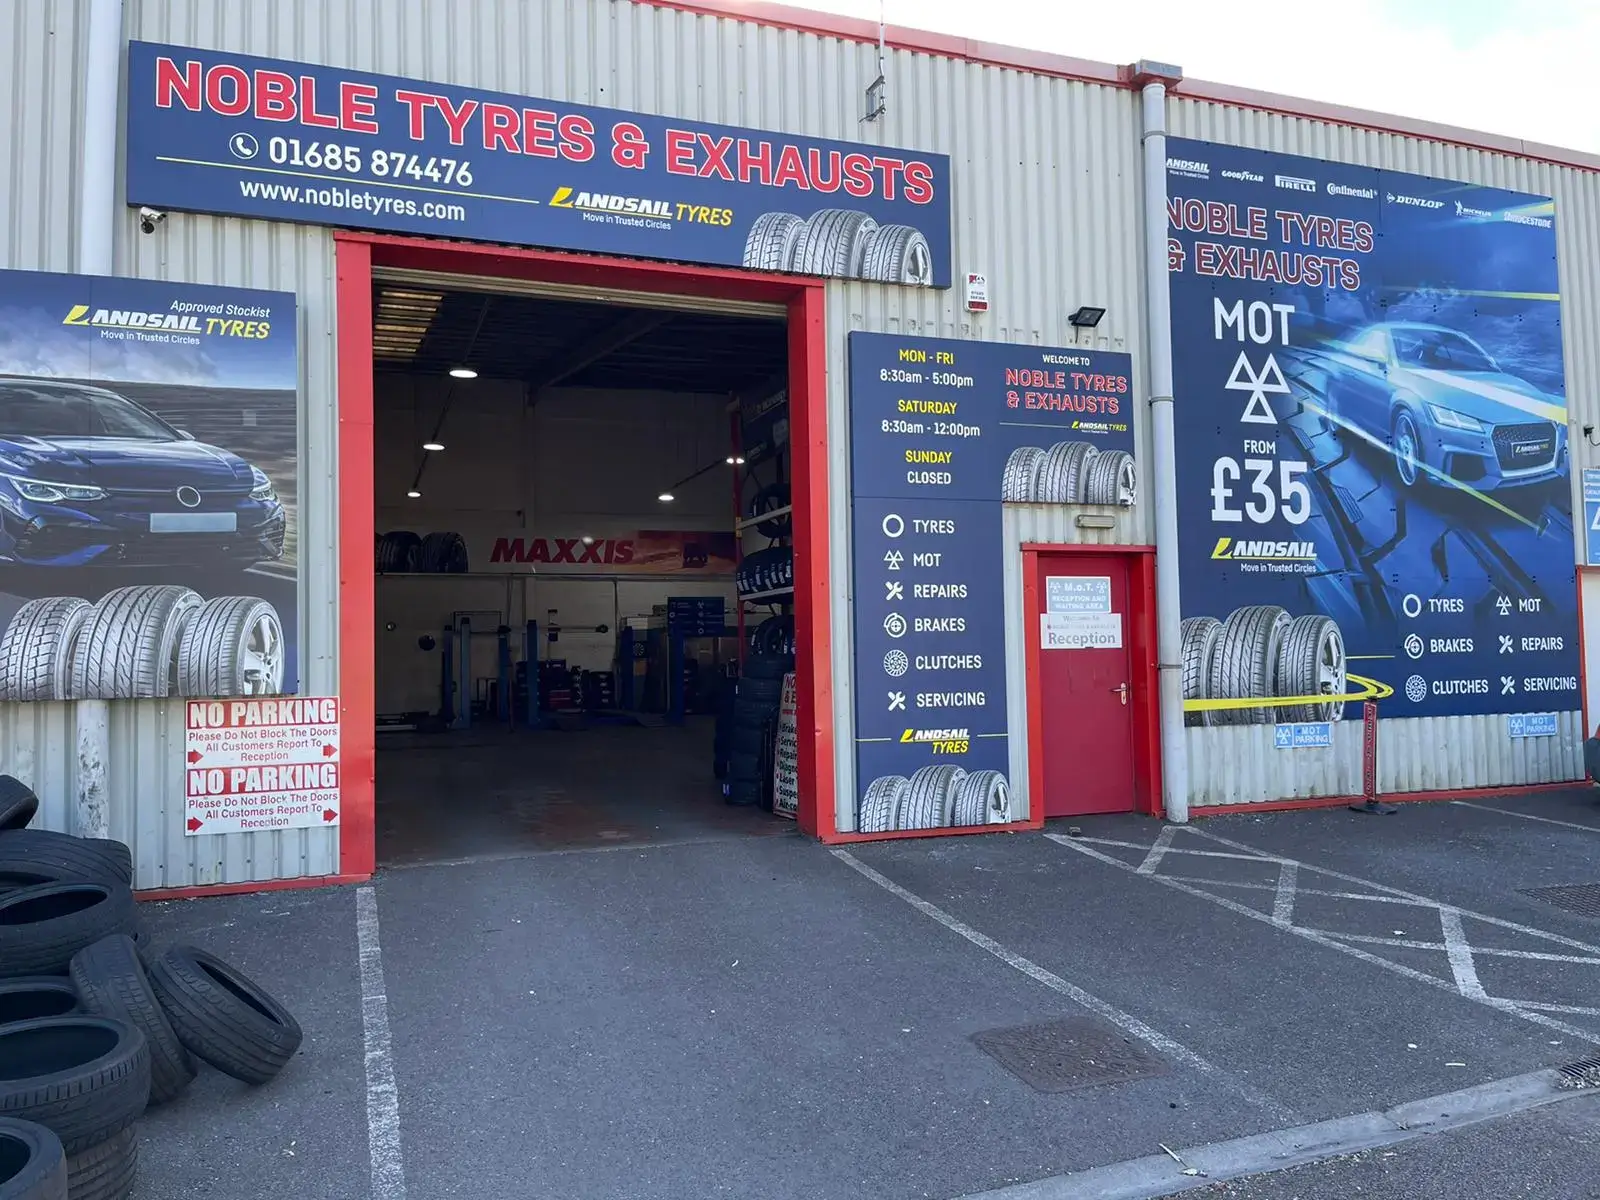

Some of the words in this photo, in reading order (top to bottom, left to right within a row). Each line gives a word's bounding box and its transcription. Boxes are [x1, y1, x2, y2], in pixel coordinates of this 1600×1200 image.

[155, 57, 379, 135] NOBLE
[396, 89, 595, 163] TYRES
[611, 121, 650, 170] &
[665, 128, 934, 204] EXHAUSTS
[269, 136, 362, 173] 01685
[371, 150, 474, 187] 874476
[1166, 158, 1210, 172] ANDSAIL
[1221, 170, 1264, 182] GOODYEAR
[1274, 174, 1316, 192] PIRELLI
[240, 179, 465, 222] www.nobletyres.com
[549, 186, 673, 217] LANDSAIL
[676, 203, 733, 226] TYRES
[1396, 195, 1443, 209] DUNLOP
[582, 213, 605, 224] Move
[605, 215, 614, 224] in
[615, 217, 645, 228] Trusted
[645, 220, 672, 231] Circles
[1167, 197, 1268, 240] NOBLE
[1276, 210, 1374, 253] TYRES
[1195, 241, 1361, 291] EXHAUSTS
[170, 300, 224, 315] Approved
[226, 304, 271, 318] Stockist
[62, 304, 202, 331] LANDSAIL
[206, 318, 271, 339] TYRES
[1213, 297, 1295, 345] MOT
[100, 330, 125, 340] Move
[126, 331, 135, 341] in
[136, 332, 170, 343] Trusted
[171, 335, 201, 345] Circles
[899, 349, 926, 362] MON
[936, 352, 954, 365] FRI
[1042, 354, 1079, 366] WELCOME
[1081, 357, 1090, 366] TO
[880, 368, 923, 383] 8:30am
[932, 372, 974, 388] 5:00pm
[1005, 368, 1066, 389] NOBLE
[1071, 372, 1128, 394] TYRES
[898, 399, 957, 414] SATURDAY
[1006, 390, 1020, 409] &
[1025, 392, 1120, 414] EXHAUSTS
[881, 419, 924, 434] 8:30am
[934, 422, 980, 438] 12:00pm
[1244, 439, 1276, 455] FROM
[905, 450, 952, 463] SUNDAY
[907, 471, 952, 485] CLOSED
[1211, 456, 1311, 525] £35
[912, 519, 955, 534] TYRES
[490, 537, 634, 564] MAXXIS
[1211, 537, 1317, 559] LANDSAIL
[913, 553, 941, 567] MOT
[1240, 563, 1259, 572] Move
[1260, 562, 1267, 572] in
[1267, 563, 1293, 573] Trusted
[1294, 563, 1317, 573] Circles
[914, 584, 968, 598] REPAIRS
[1428, 598, 1464, 613] TYRES
[1518, 598, 1541, 612] MOT
[914, 617, 966, 632] BRAKES
[1048, 632, 1116, 647] Reception
[1430, 638, 1474, 653] BRAKES
[1521, 637, 1563, 651] REPAIRS
[915, 655, 982, 670] CLUTCHES
[1432, 679, 1489, 695] CLUTCHES
[1524, 676, 1577, 692] SERVICING
[916, 692, 985, 707] SERVICING
[190, 702, 225, 728] NO
[231, 699, 336, 727] PARKING
[189, 732, 221, 742] Please
[224, 731, 238, 740] Do
[240, 730, 258, 740] Not
[260, 729, 287, 739] Block
[290, 728, 307, 737] The
[310, 727, 337, 737] Doors
[900, 728, 970, 742] LANDSAIL
[1302, 726, 1321, 735] MOT
[206, 743, 218, 752] All
[221, 741, 274, 751] Customers
[277, 740, 309, 750] Report
[311, 738, 322, 747] To
[1295, 735, 1329, 744] PARKING
[932, 741, 969, 754] TYRES
[241, 751, 289, 762] Reception
[190, 769, 225, 795] NO
[230, 764, 337, 793] PARKING
[189, 799, 221, 809] Please
[224, 798, 238, 807] Do
[240, 797, 258, 807] Not
[260, 795, 287, 805] Block
[290, 794, 308, 804] The
[310, 793, 338, 803] Doors
[205, 810, 218, 820] All
[221, 808, 274, 818] Customers
[277, 806, 309, 817] Report
[311, 803, 322, 812] To
